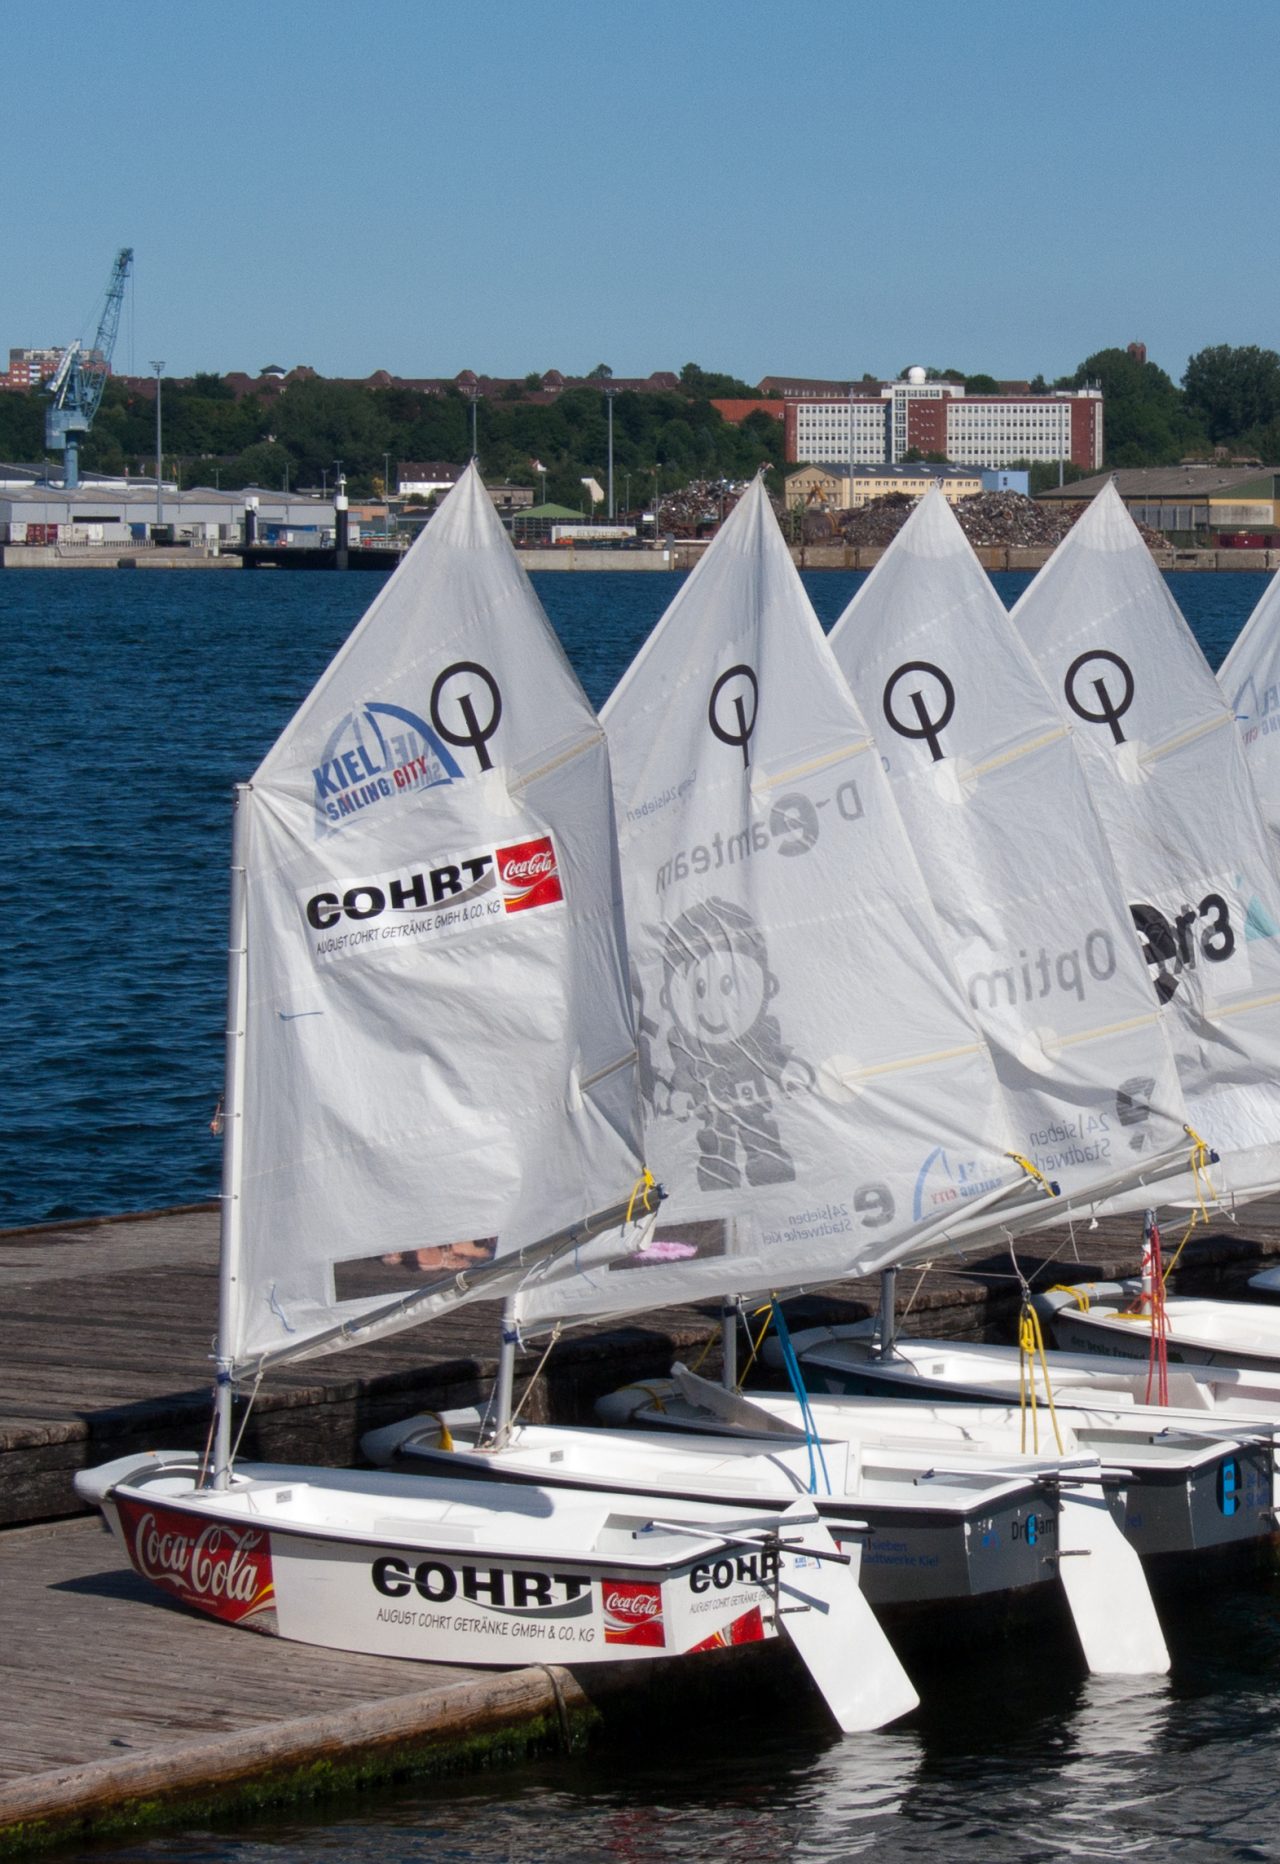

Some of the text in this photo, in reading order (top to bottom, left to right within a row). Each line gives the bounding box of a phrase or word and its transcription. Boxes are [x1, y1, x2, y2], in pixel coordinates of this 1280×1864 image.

[312, 745, 381, 800] KIEL
[326, 778, 390, 821] SAILING
[393, 756, 427, 788] CITY
[307, 851, 552, 930] COHRT Coca-Cola
[316, 900, 501, 954] AUGUST COHRT GETRÄNKE GMBH & CO. KG
[136, 1513, 262, 1601] Coca-Cola
[372, 1557, 661, 1616] COHRT Coca-Cola
[376, 1608, 595, 1642] AUGUST COHRT GETRÄNKE GMBH & CO. KG
